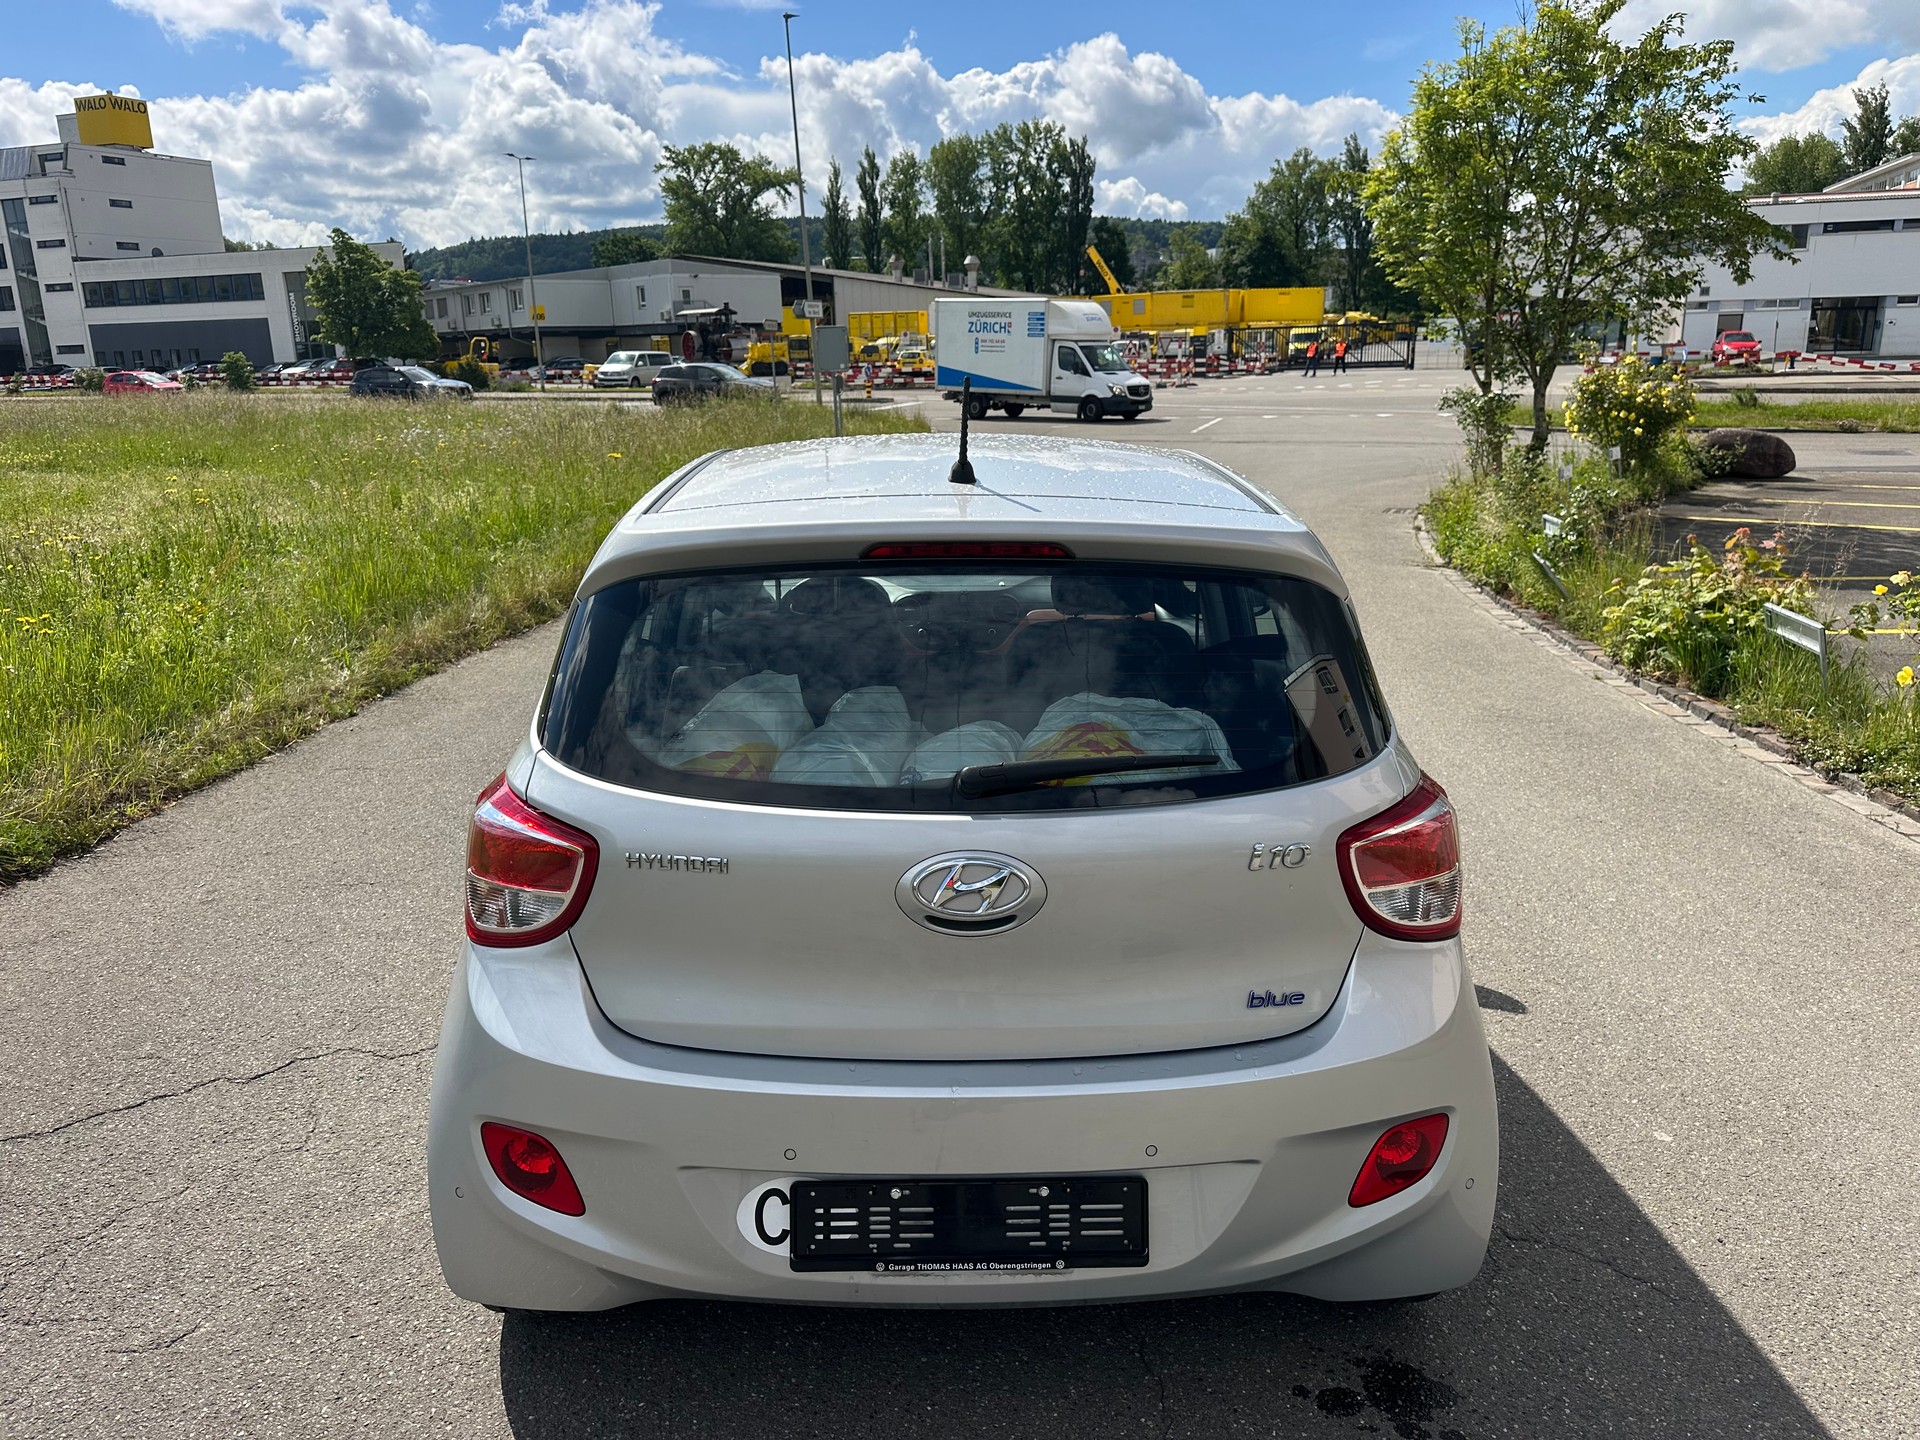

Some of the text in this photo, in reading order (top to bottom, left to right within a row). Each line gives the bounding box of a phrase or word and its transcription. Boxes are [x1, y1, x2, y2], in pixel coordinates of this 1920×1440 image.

[75, 97, 107, 112] WALO
[109, 97, 147, 114] WALO
[289, 292, 301, 342] SHOWROOM
[968, 319, 1007, 333] ZÜRICH
[625, 852, 729, 874] HYUNDAI
[1248, 842, 1312, 871] i10
[1247, 990, 1305, 1009] blue
[888, 1263, 915, 1271] Garage
[952, 1262, 974, 1270] HAAS
[975, 1262, 988, 1270] AG
[989, 1262, 1051, 1270] Oberengstringen
